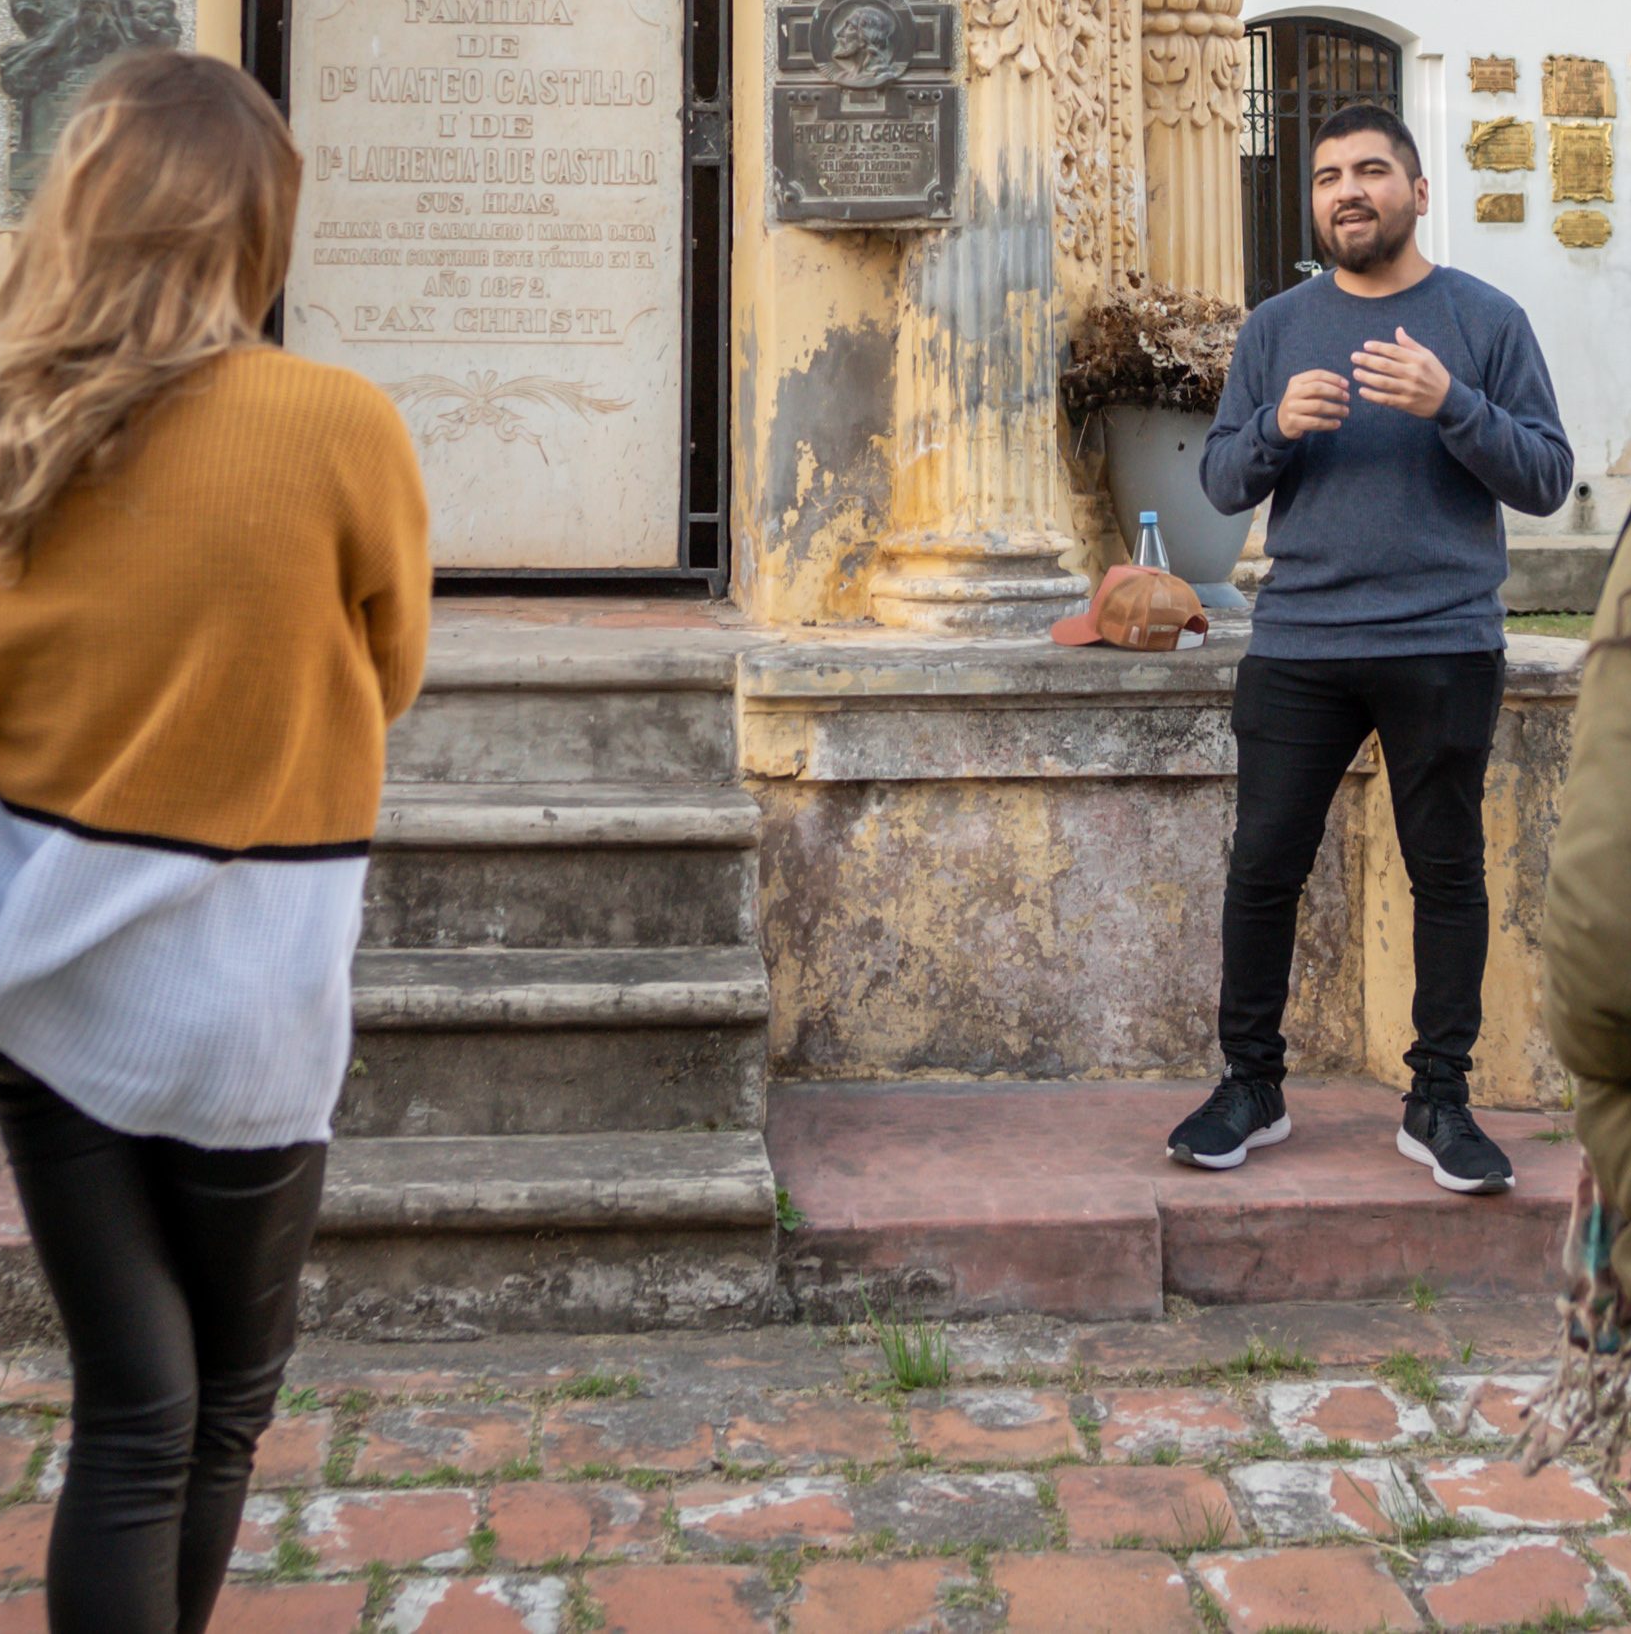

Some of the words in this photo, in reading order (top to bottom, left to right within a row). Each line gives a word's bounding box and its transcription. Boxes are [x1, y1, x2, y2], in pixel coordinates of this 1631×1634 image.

[457, 35, 519, 58] DE
[369, 68, 482, 103] MATEO
[495, 70, 655, 105] CASTILLO
[470, 115, 533, 138] DE
[349, 147, 476, 183] LAURENCIA
[481, 192, 559, 216] HIJAS,
[314, 222, 383, 239] JULIANA
[429, 223, 522, 241] CABALLERO
[538, 224, 601, 241] MAXIMA
[608, 225, 656, 242] OJEDA
[493, 250, 533, 266] ESTE
[608, 251, 632, 268] EN
[634, 252, 654, 269] EL
[423, 271, 471, 297] AÑO
[354, 307, 436, 331] PAX
[454, 307, 617, 333] CHRISTI
